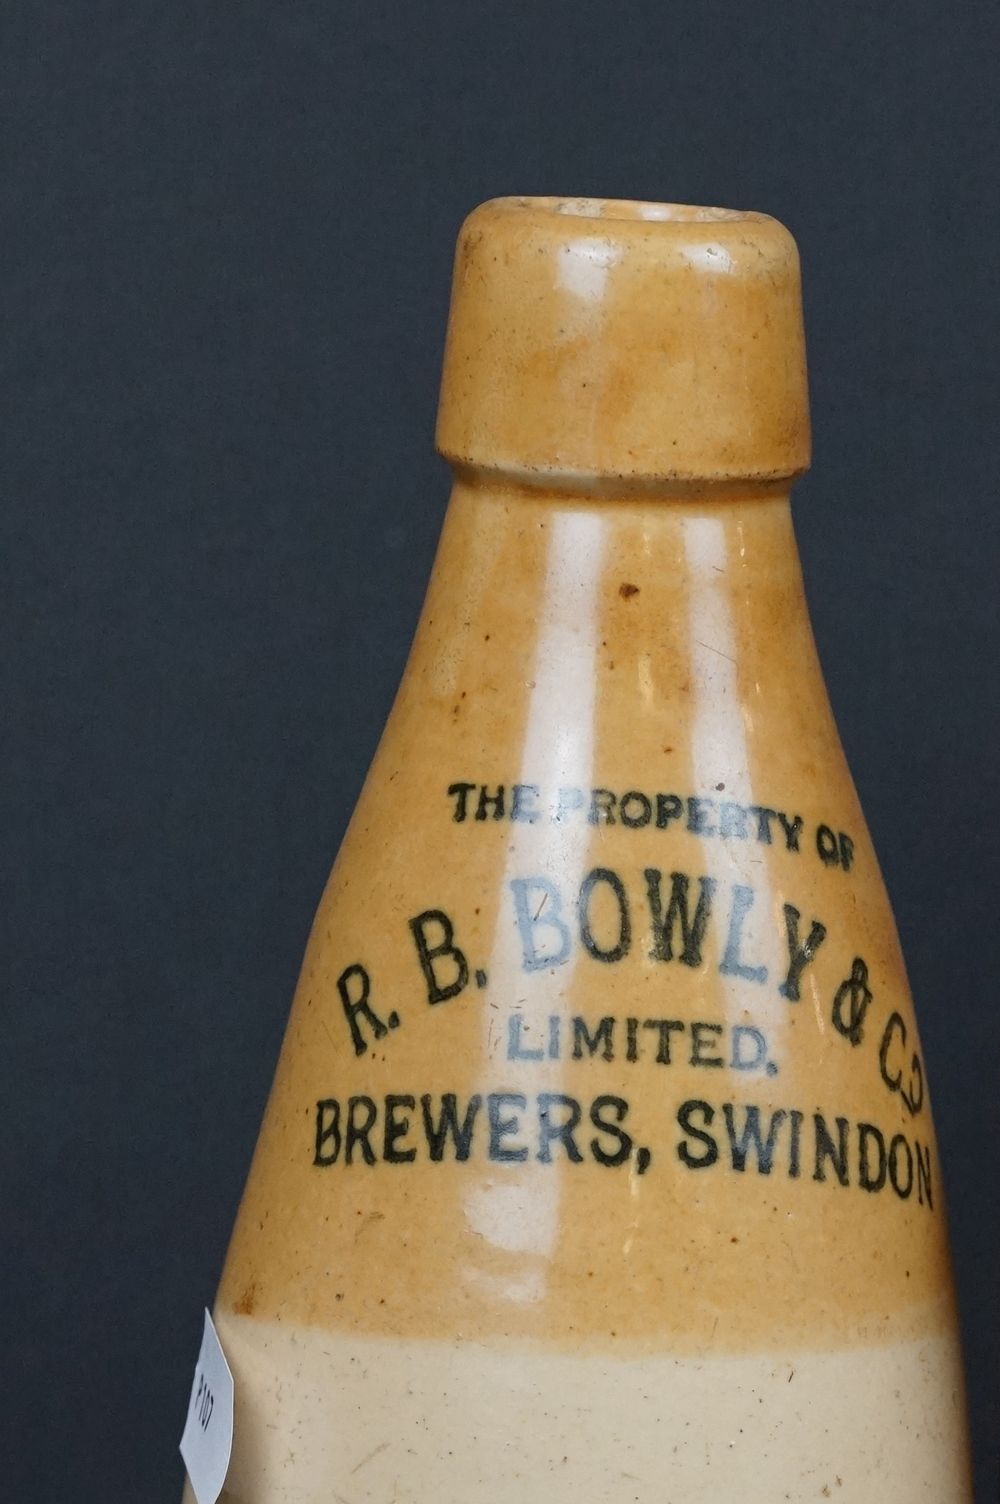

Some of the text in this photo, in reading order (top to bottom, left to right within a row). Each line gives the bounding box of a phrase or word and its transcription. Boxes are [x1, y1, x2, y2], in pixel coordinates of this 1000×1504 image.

[447, 782, 856, 872] THE PROPERTY OF
[336, 963, 401, 1057] R.
[408, 908, 488, 1005] B.
[509, 867, 829, 1004] BOWLY
[831, 957, 874, 1047] &
[507, 1013, 780, 1079] LIMITED.
[313, 1093, 934, 1211] BREWERS, SWINDON
